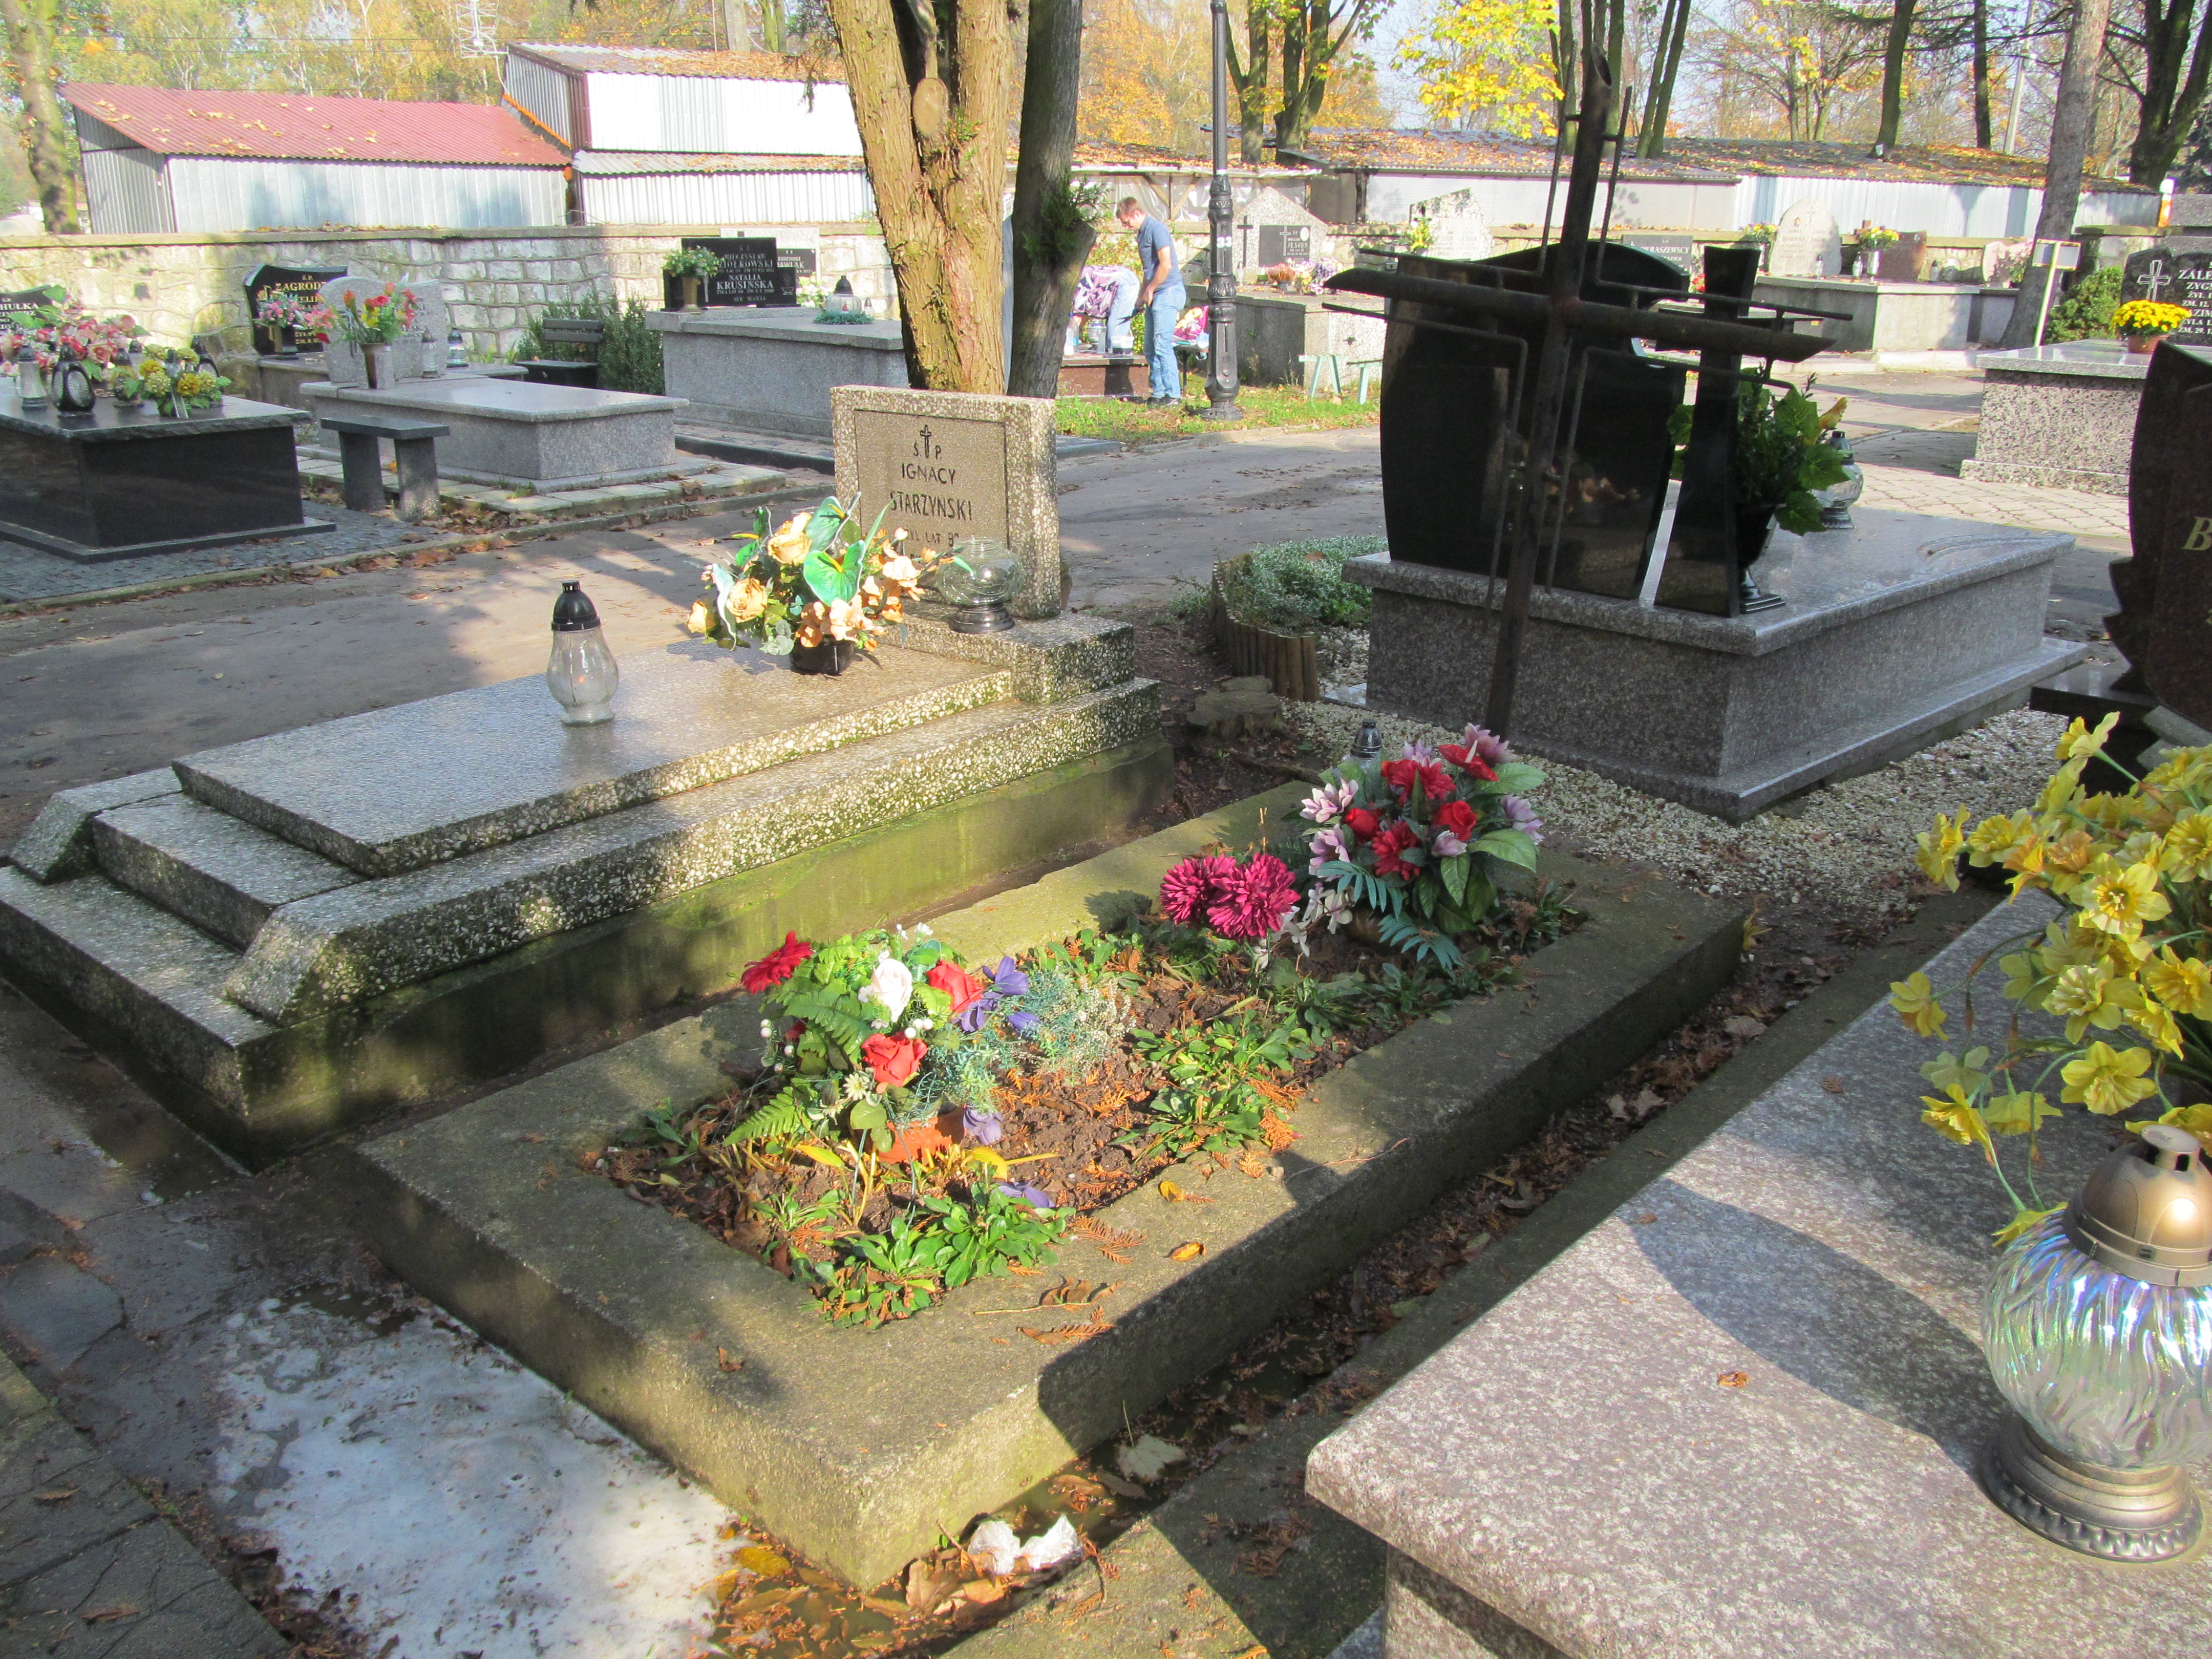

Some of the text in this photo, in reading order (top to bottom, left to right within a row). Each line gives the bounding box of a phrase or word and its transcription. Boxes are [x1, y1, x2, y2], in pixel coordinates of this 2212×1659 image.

[275, 282, 326, 292] ZAGROD
[902, 463, 956, 484] IGNACY
[925, 531, 941, 544] LAT
